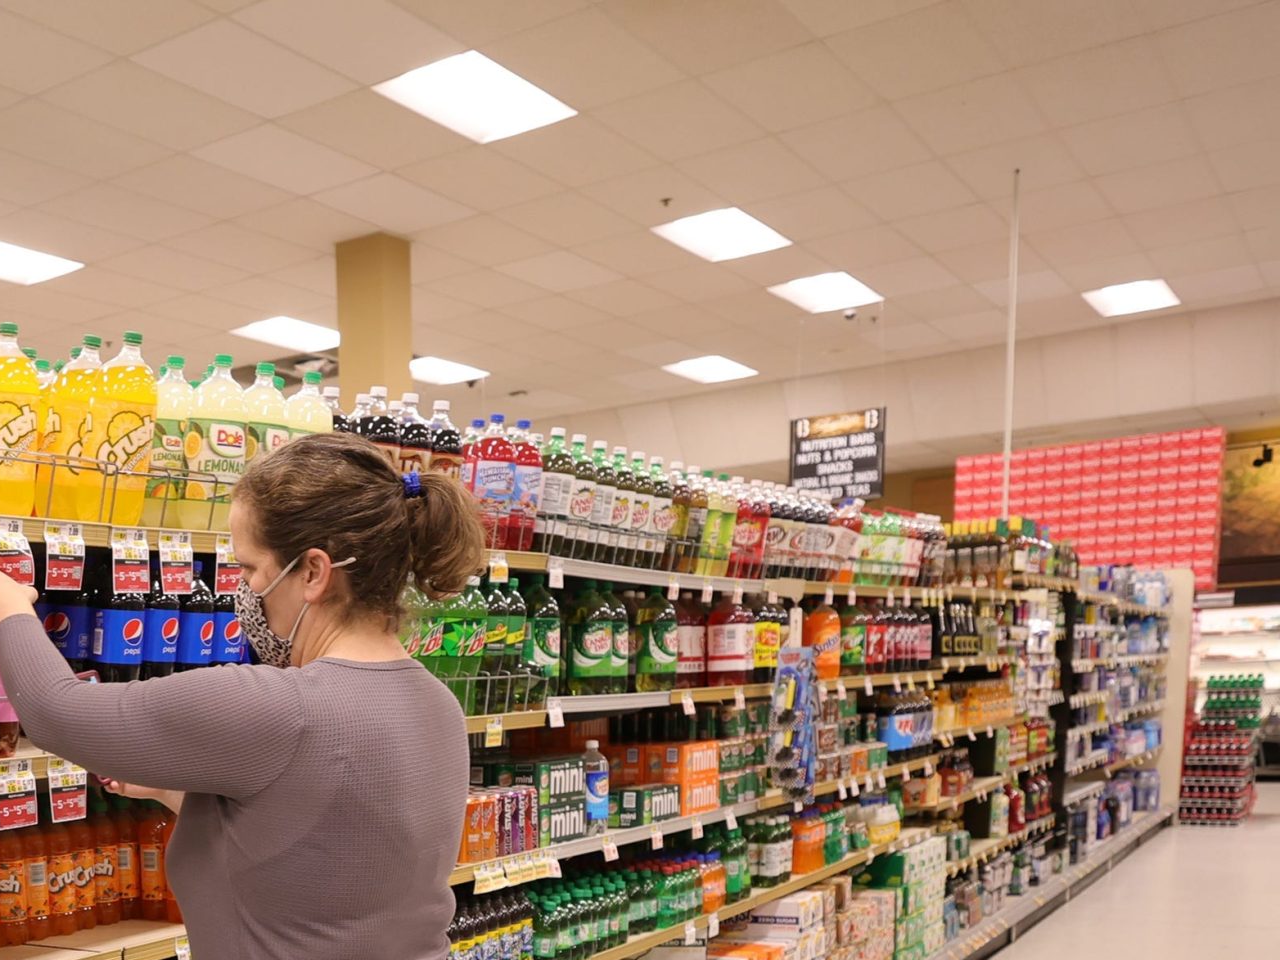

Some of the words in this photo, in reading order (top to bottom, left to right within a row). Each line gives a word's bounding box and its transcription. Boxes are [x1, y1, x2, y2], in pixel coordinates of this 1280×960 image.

[217, 429, 243, 445] Dole
[550, 762, 584, 794] mini
[551, 803, 584, 838] mini
